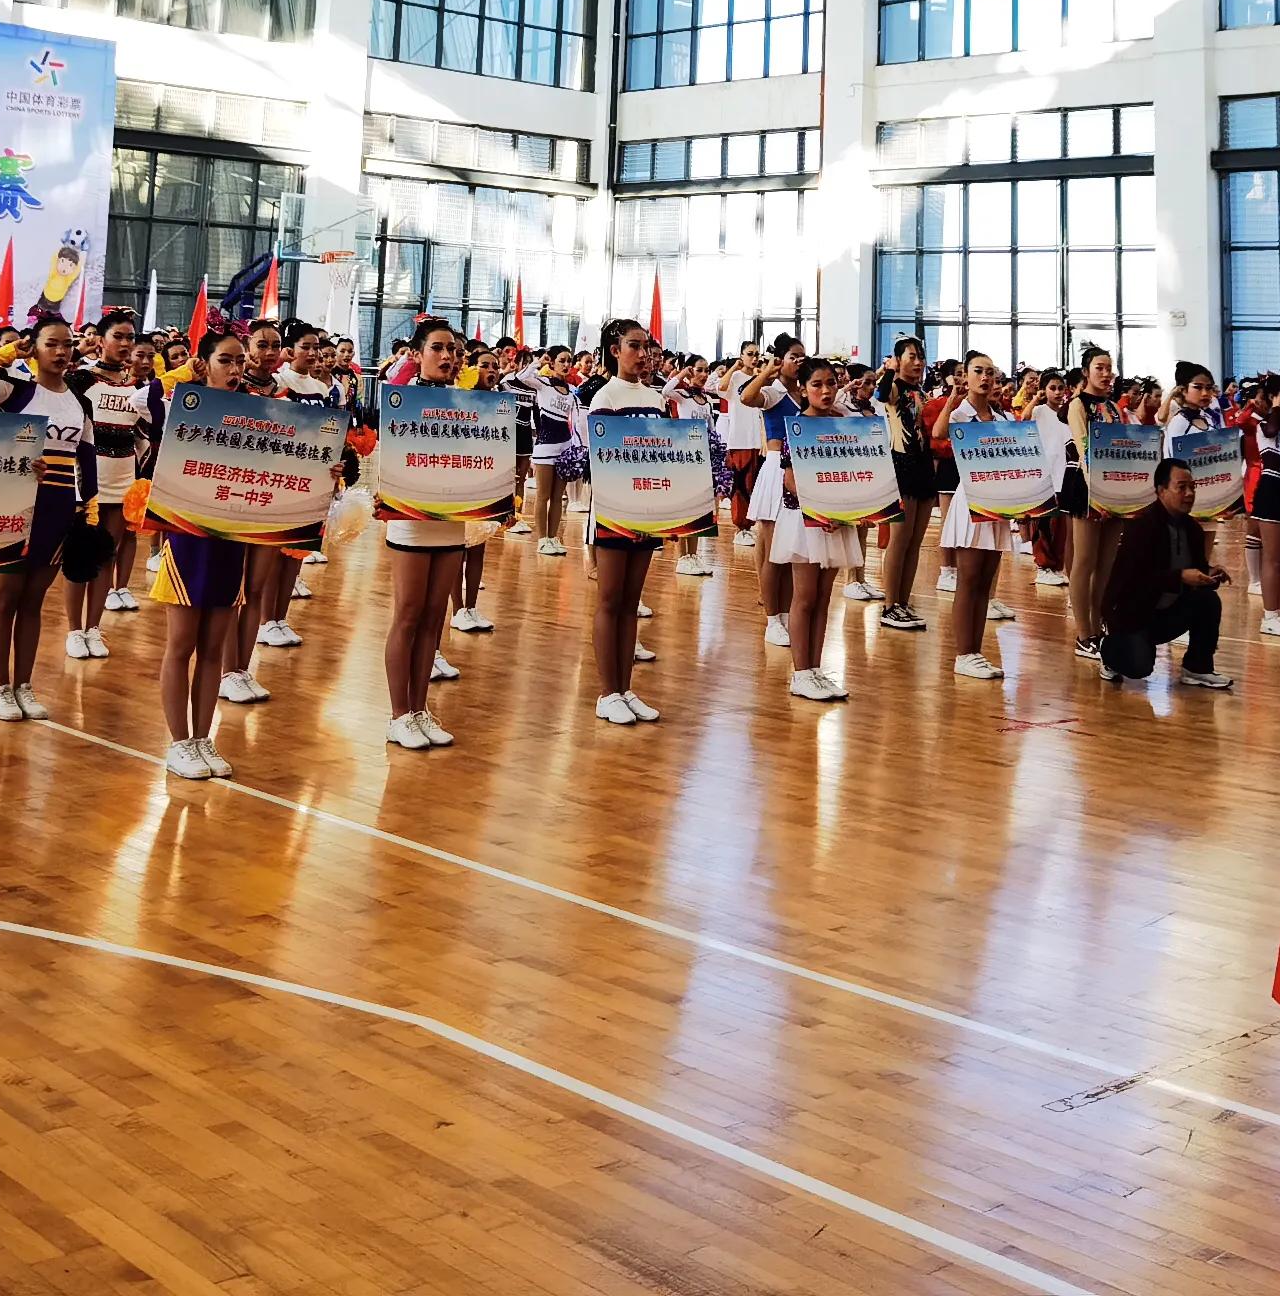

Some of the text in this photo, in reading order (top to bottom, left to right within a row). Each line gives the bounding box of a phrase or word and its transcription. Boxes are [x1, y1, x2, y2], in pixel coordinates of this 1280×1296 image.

[6, 91, 81, 110] 中国体育彩票
[406, 452, 494, 470] 黄冈中学昆明分校
[182, 459, 312, 493] 昆明经济技术开发区
[632, 476, 672, 491] 高新三中
[214, 485, 274, 507] 第一中学
